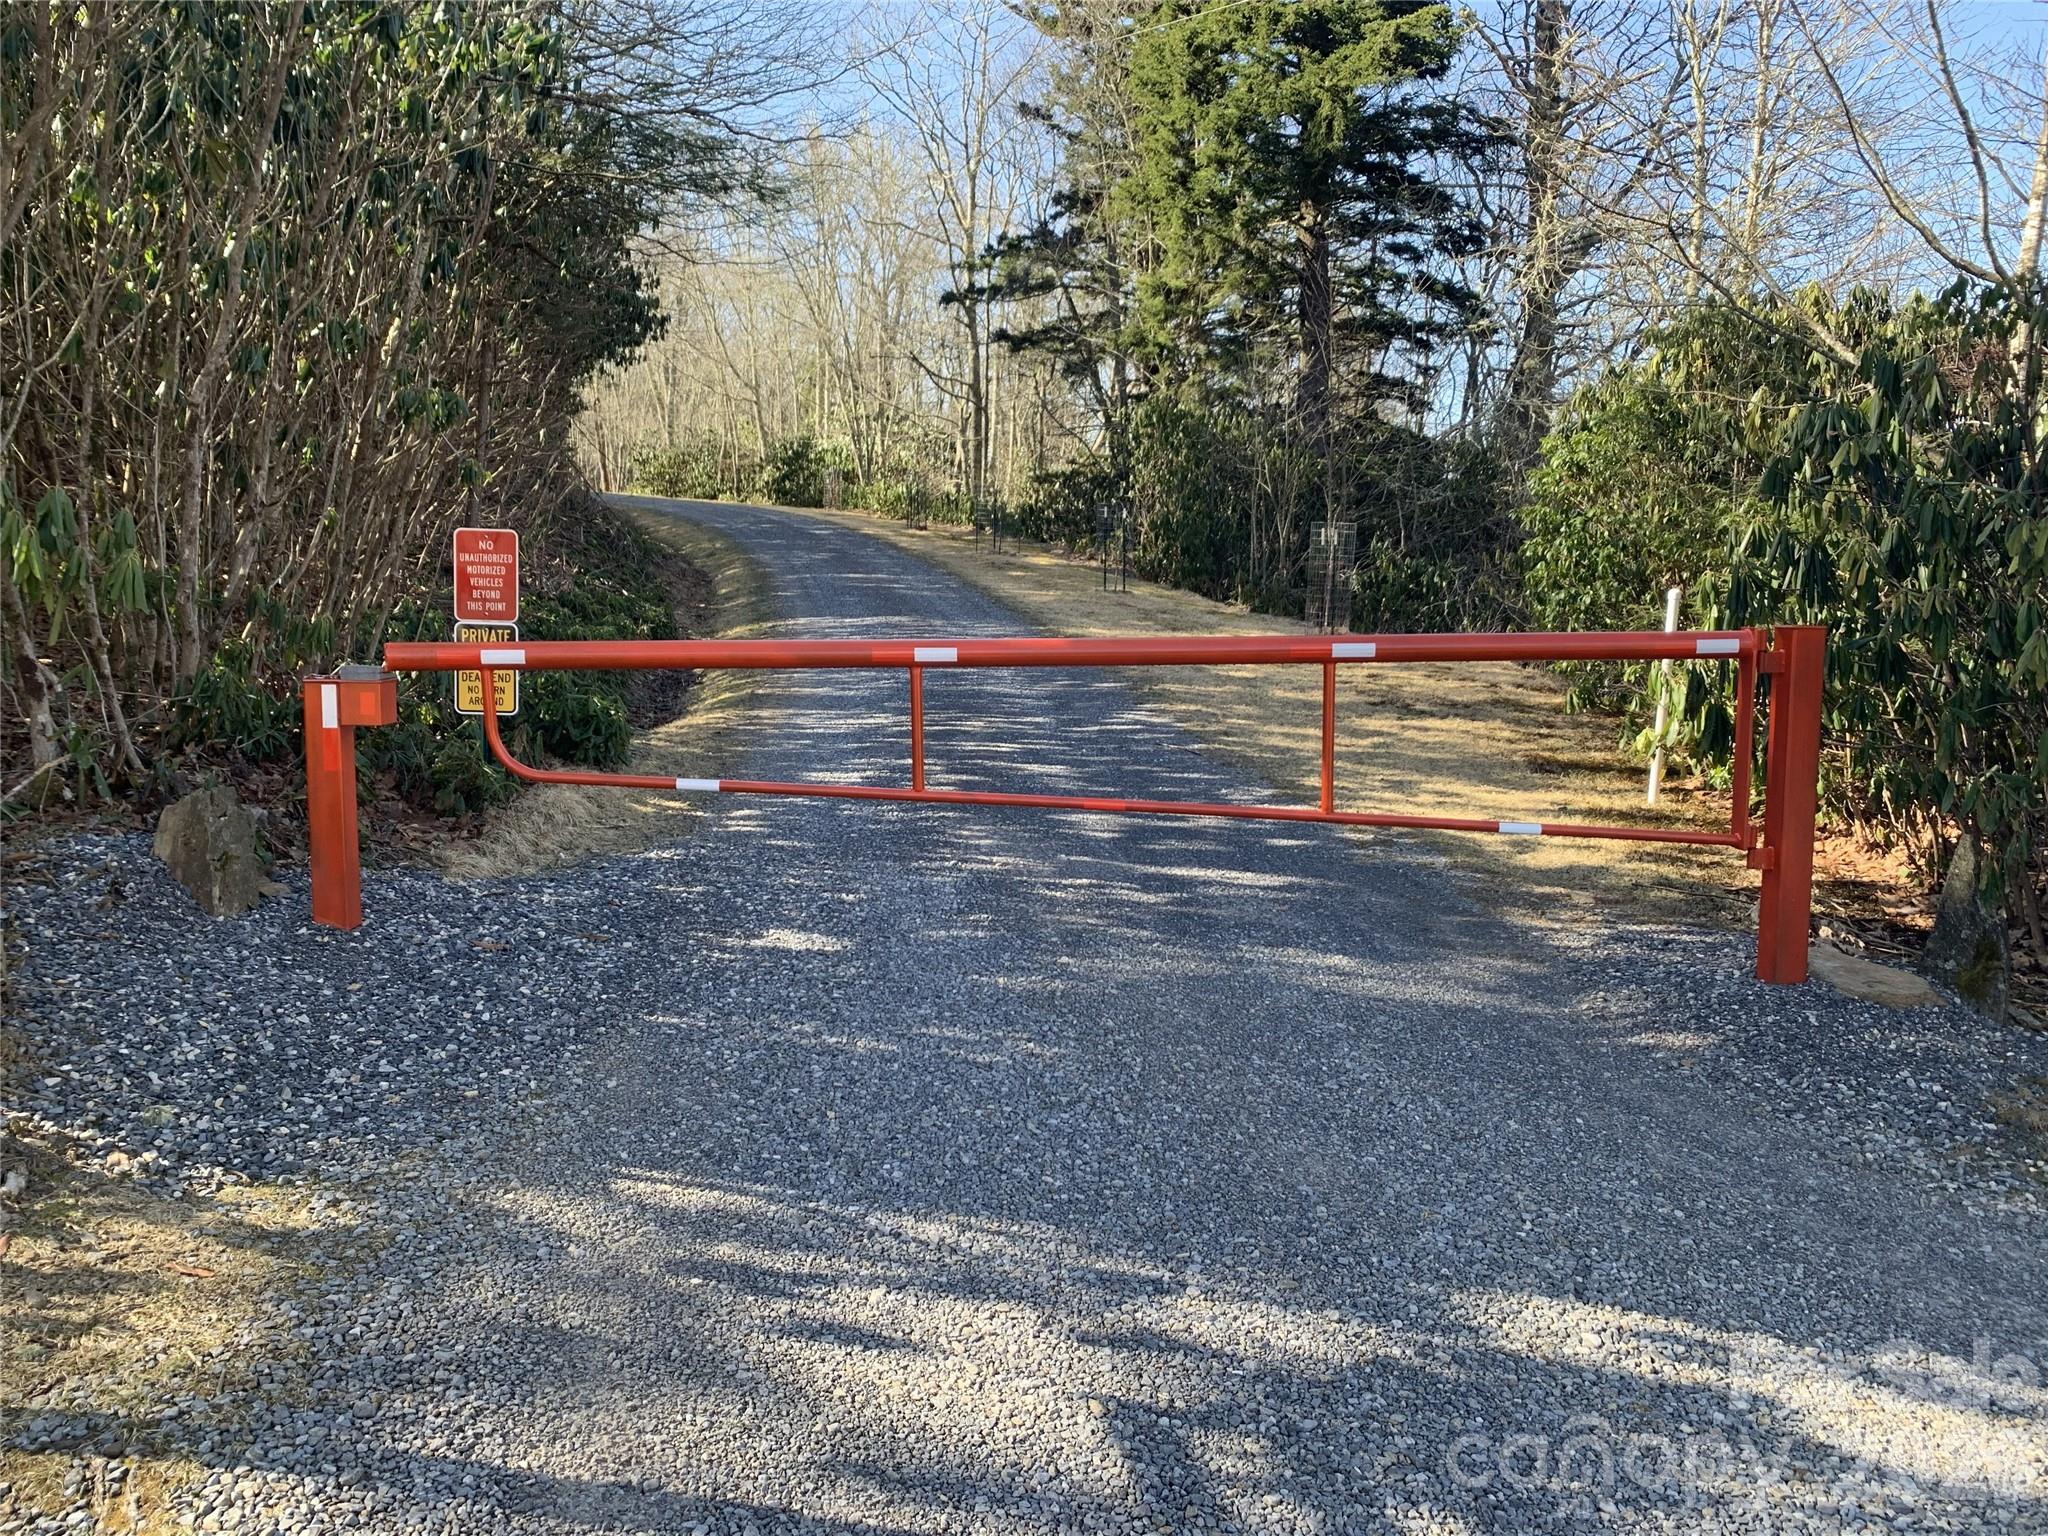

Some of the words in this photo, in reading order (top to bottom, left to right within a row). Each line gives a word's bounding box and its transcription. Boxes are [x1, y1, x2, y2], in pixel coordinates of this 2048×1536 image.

[478, 540, 494, 550] NO
[459, 553, 513, 563] UNAUTHORIZED
[467, 565, 506, 575] MOTORIZED
[469, 577, 504, 587] VEHICLES
[472, 590, 500, 599] BEYOND
[467, 602, 483, 611] THIS
[485, 602, 506, 612] POINT
[461, 628, 511, 643] PRIVATE
[461, 672, 481, 682] DEA
[467, 685, 480, 695] NO
